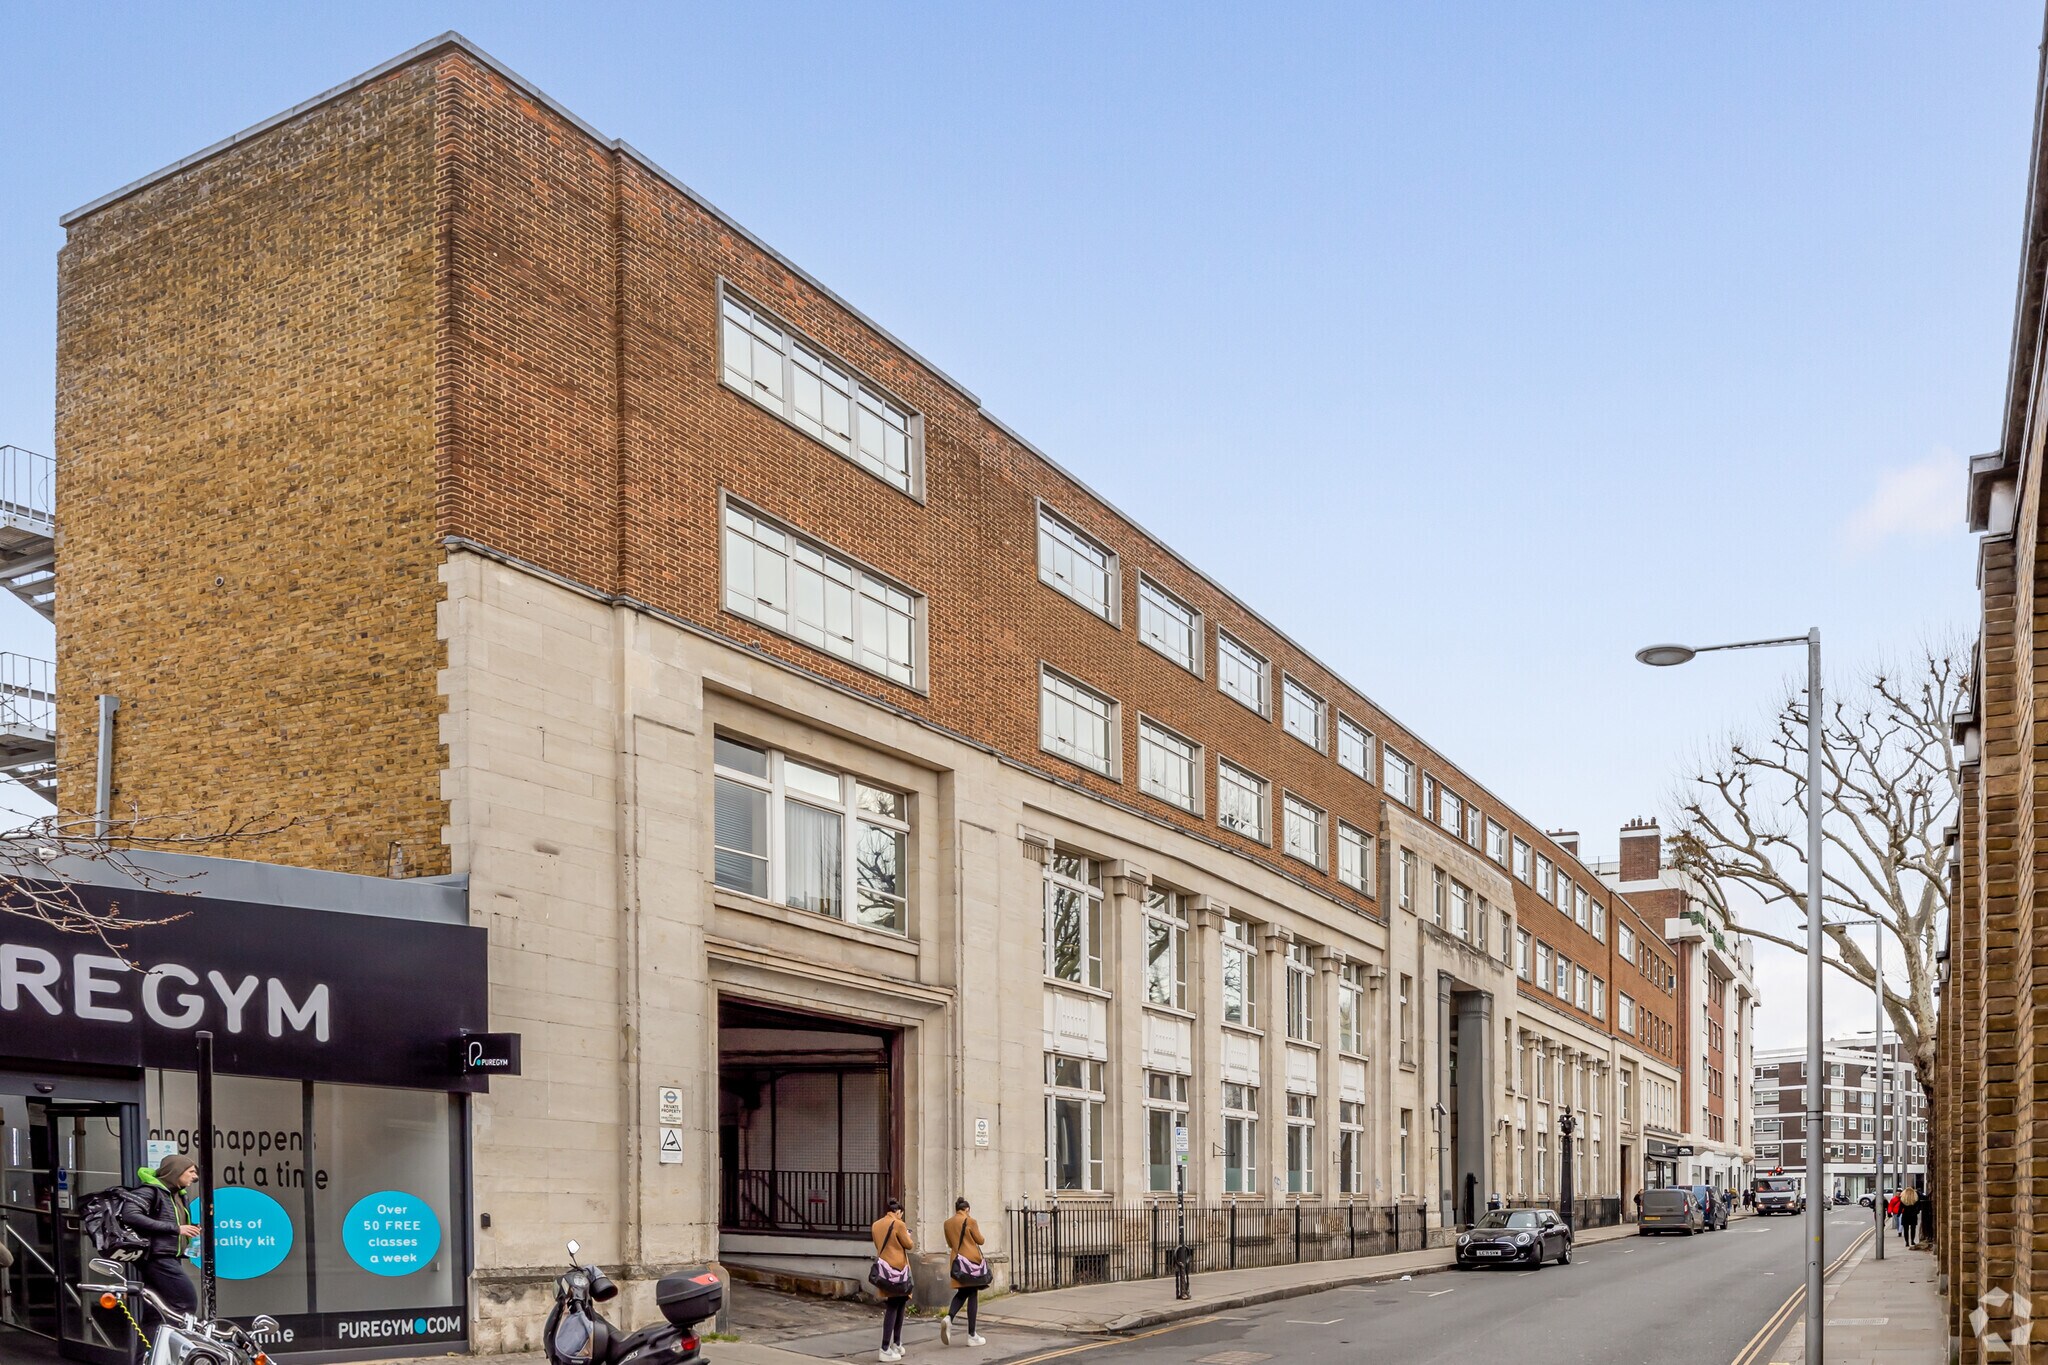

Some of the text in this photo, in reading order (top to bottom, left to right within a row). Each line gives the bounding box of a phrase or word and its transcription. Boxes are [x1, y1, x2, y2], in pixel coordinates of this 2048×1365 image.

[0, 943, 330, 1042] REGYM
[481, 1058, 508, 1066] PUREGYM
[212, 1125, 317, 1156] happen
[223, 1161, 245, 1185] at
[253, 1167, 268, 1187] a
[377, 1204, 408, 1215] Over
[247, 1218, 263, 1229] of
[363, 1220, 421, 1231] 50 FREE
[214, 1235, 276, 1249] ality kit
[368, 1237, 418, 1247] classes
[370, 1253, 417, 1263] a week
